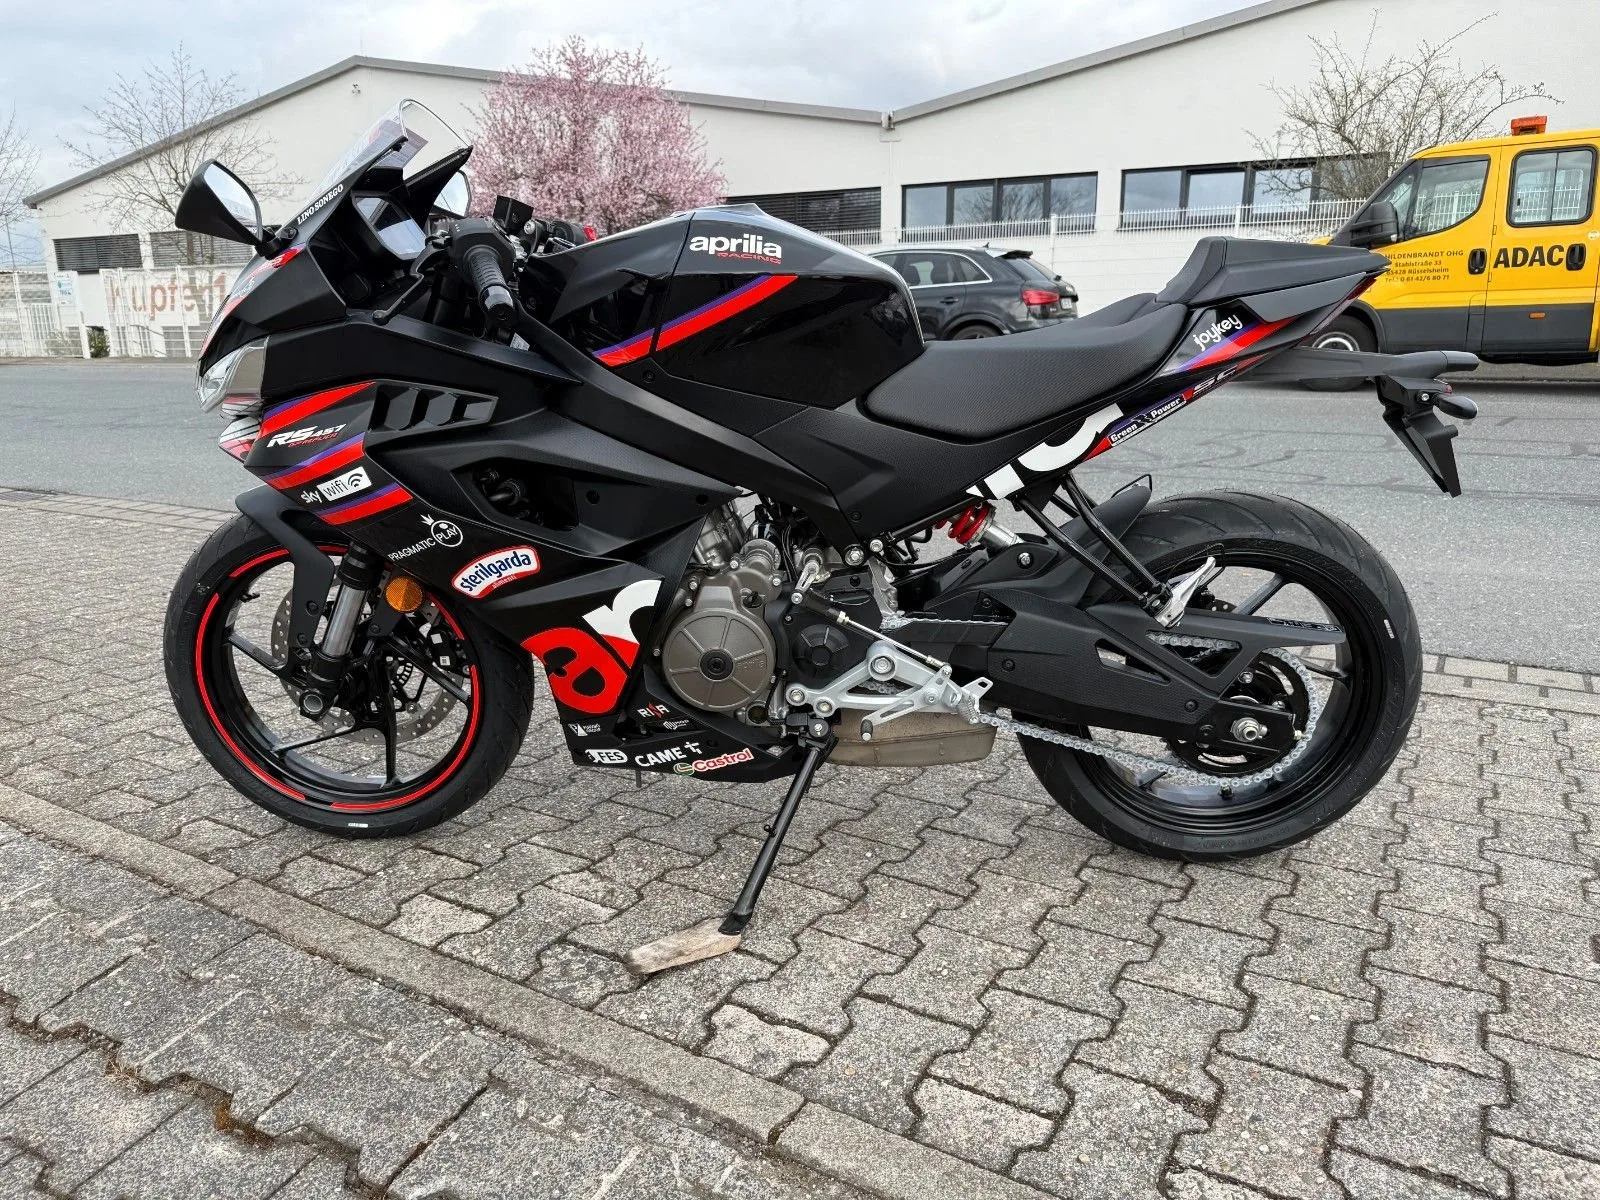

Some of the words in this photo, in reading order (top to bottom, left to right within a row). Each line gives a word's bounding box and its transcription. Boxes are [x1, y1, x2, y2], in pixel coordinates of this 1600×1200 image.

[297, 206, 315, 224] LINO
[314, 184, 344, 211] SONEGO
[689, 233, 782, 259] aprilia
[717, 252, 782, 265] RACING
[1385, 251, 1445, 260] HILDENBRANDT
[1493, 245, 1565, 269] ADAC
[1408, 266, 1449, 274] Rüsselsheim
[1192, 315, 1243, 351] joykey
[1110, 424, 1138, 443] Green
[1150, 398, 1181, 418] Power
[300, 489, 323, 504] sky
[323, 479, 349, 497] wifi
[387, 537, 436, 562] PRAGMATIC
[436, 526, 459, 542] PLAY
[460, 551, 532, 592] sterilgarda
[635, 747, 688, 767] CAME
[692, 748, 755, 772] Castrol
